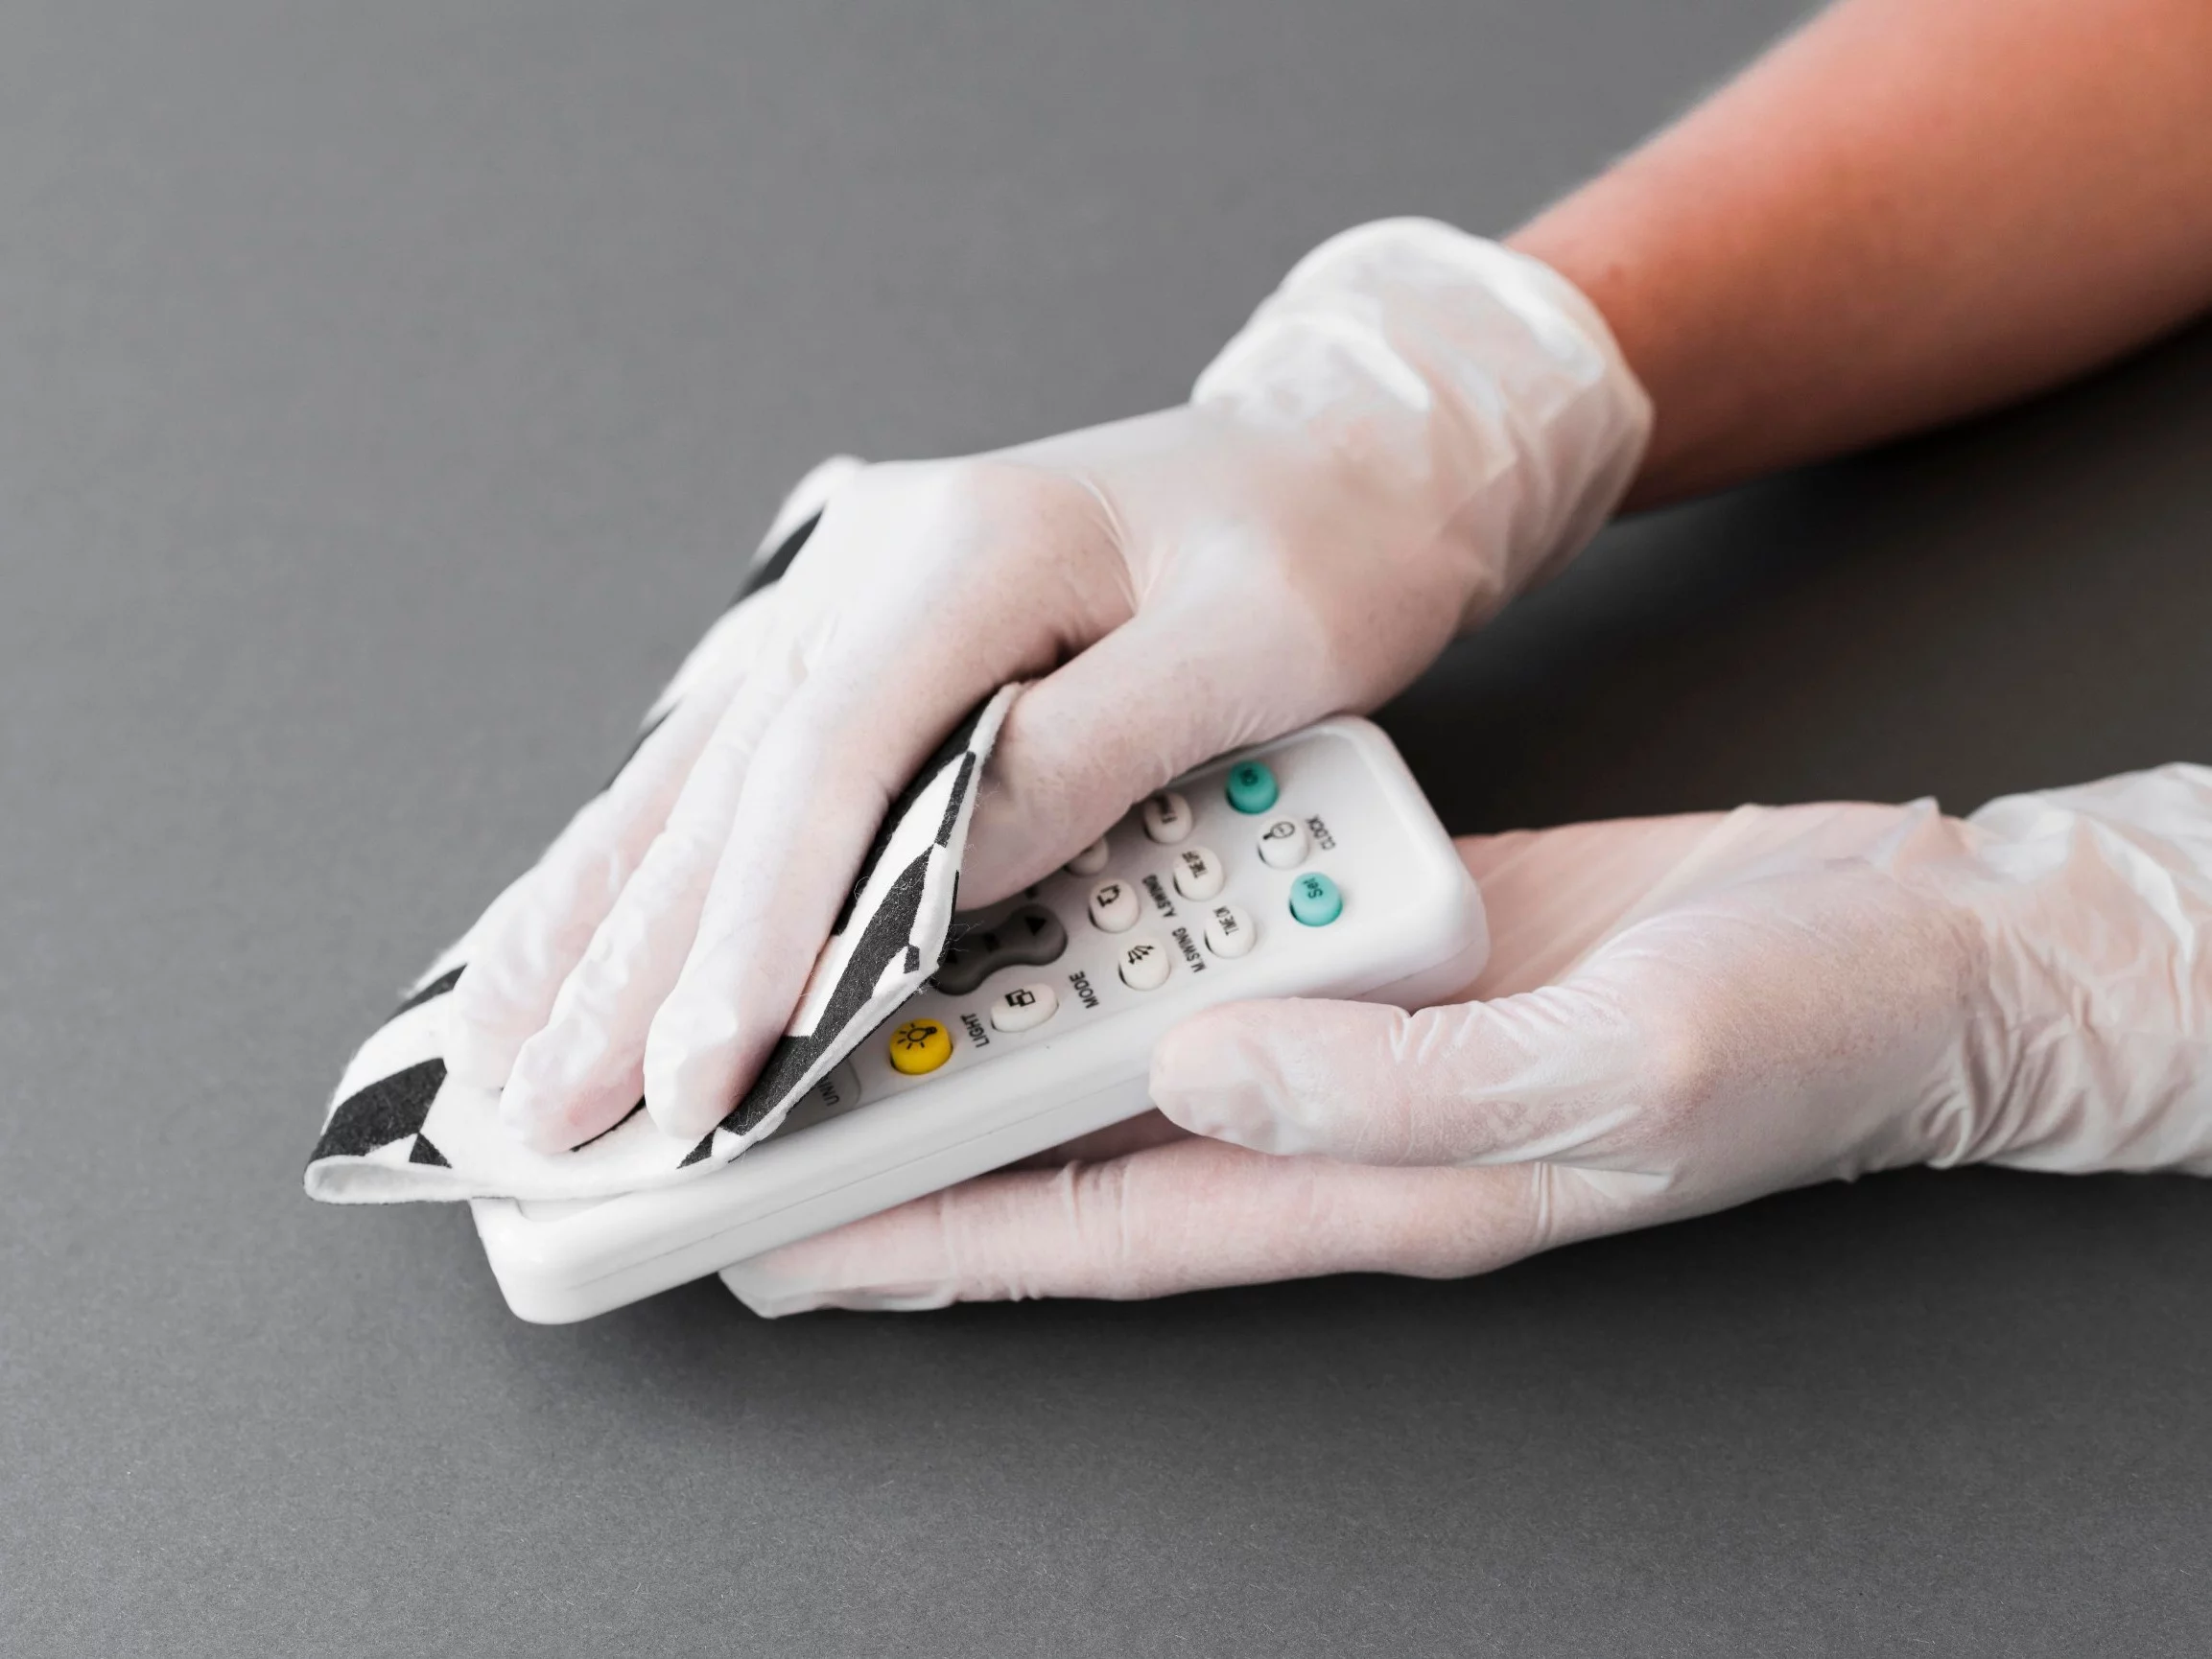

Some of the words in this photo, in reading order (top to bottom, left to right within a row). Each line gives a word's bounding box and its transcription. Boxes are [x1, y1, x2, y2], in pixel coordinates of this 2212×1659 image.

[1305, 814, 1336, 851] CLOCK
[1303, 877, 1324, 899] Set
[1171, 926, 1207, 973] M.SWING
[1069, 970, 1100, 1009] MODE
[960, 1013, 990, 1048] LIGHT
